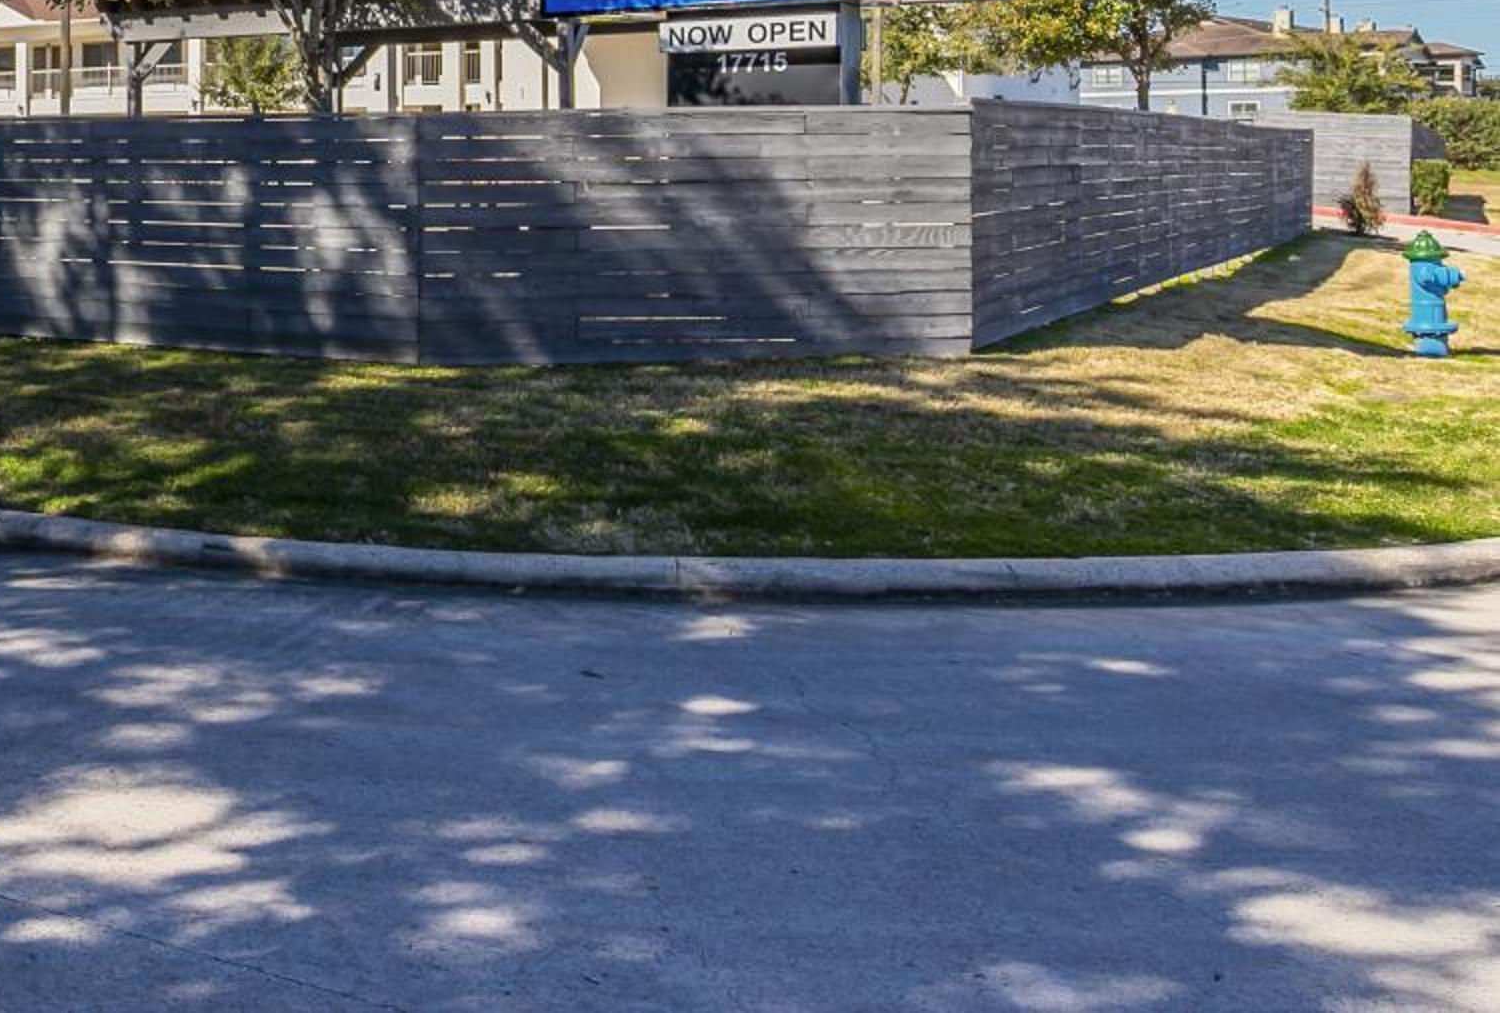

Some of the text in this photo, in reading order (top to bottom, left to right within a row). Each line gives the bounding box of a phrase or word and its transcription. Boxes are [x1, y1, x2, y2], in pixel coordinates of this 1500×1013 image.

[668, 20, 827, 47] NOW OPEN
[717, 51, 789, 74] 17715
